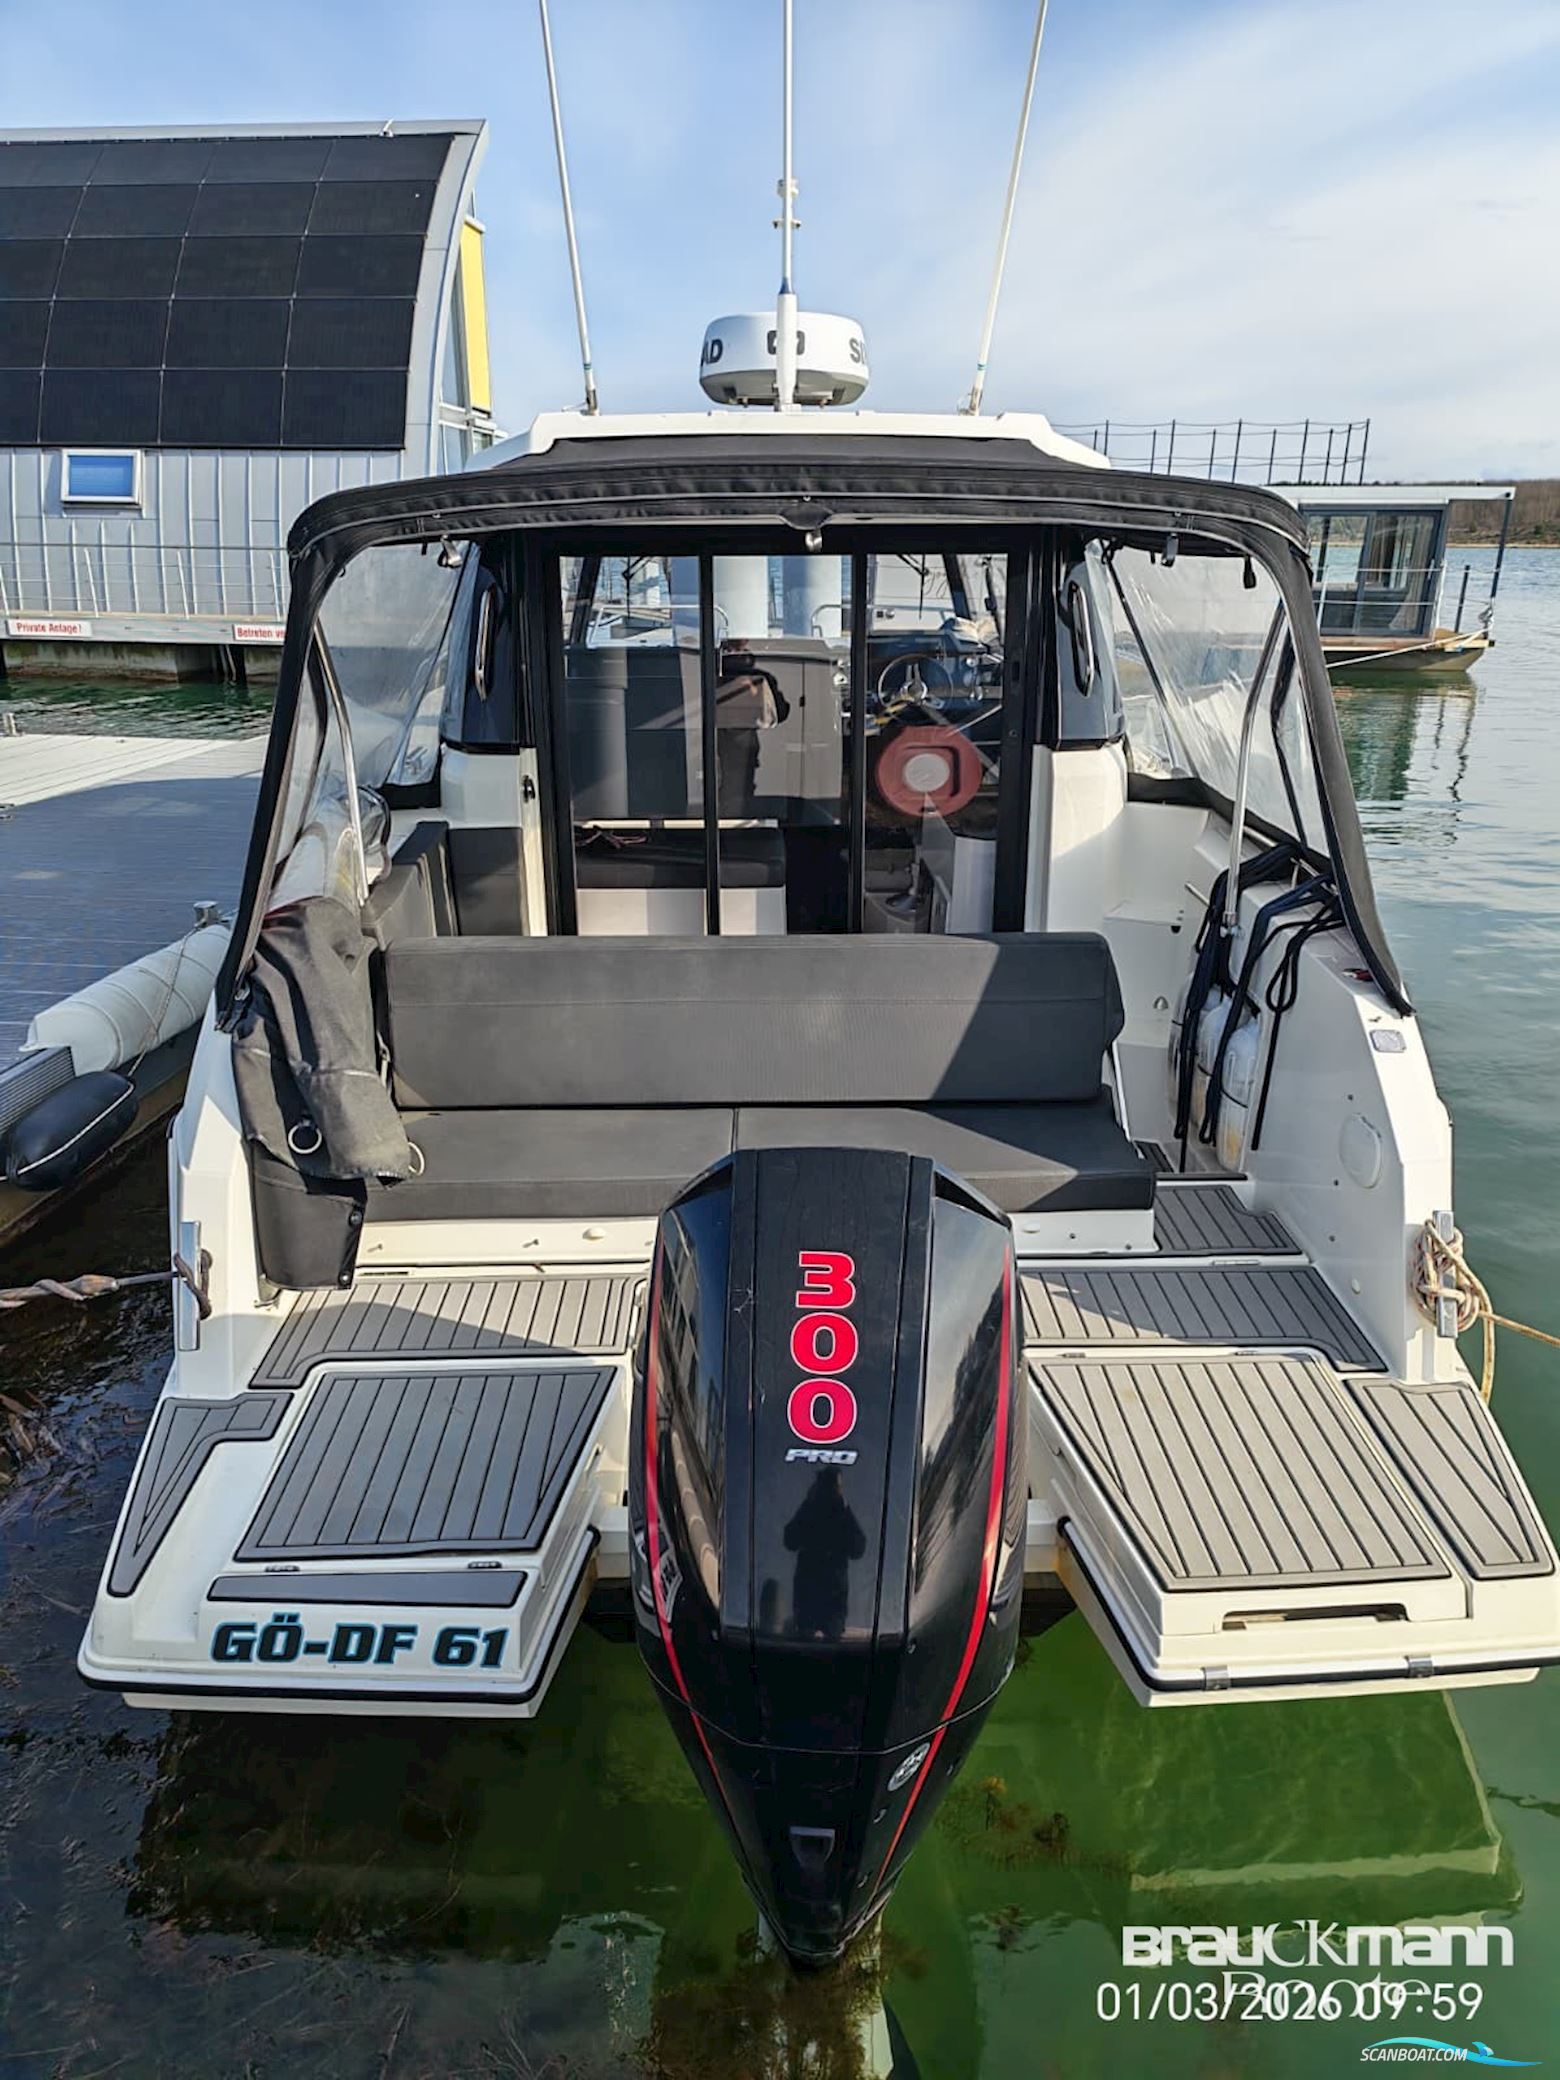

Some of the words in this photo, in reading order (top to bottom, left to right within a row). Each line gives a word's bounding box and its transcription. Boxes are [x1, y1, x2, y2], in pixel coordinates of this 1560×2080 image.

[16, 622, 46, 633] Private
[237, 627, 273, 638] Betreten
[787, 1251, 858, 1444] 300
[785, 1449, 858, 1465] PRO
[210, 1612, 418, 1664] GÖ-DF
[432, 1626, 509, 1668] 61
